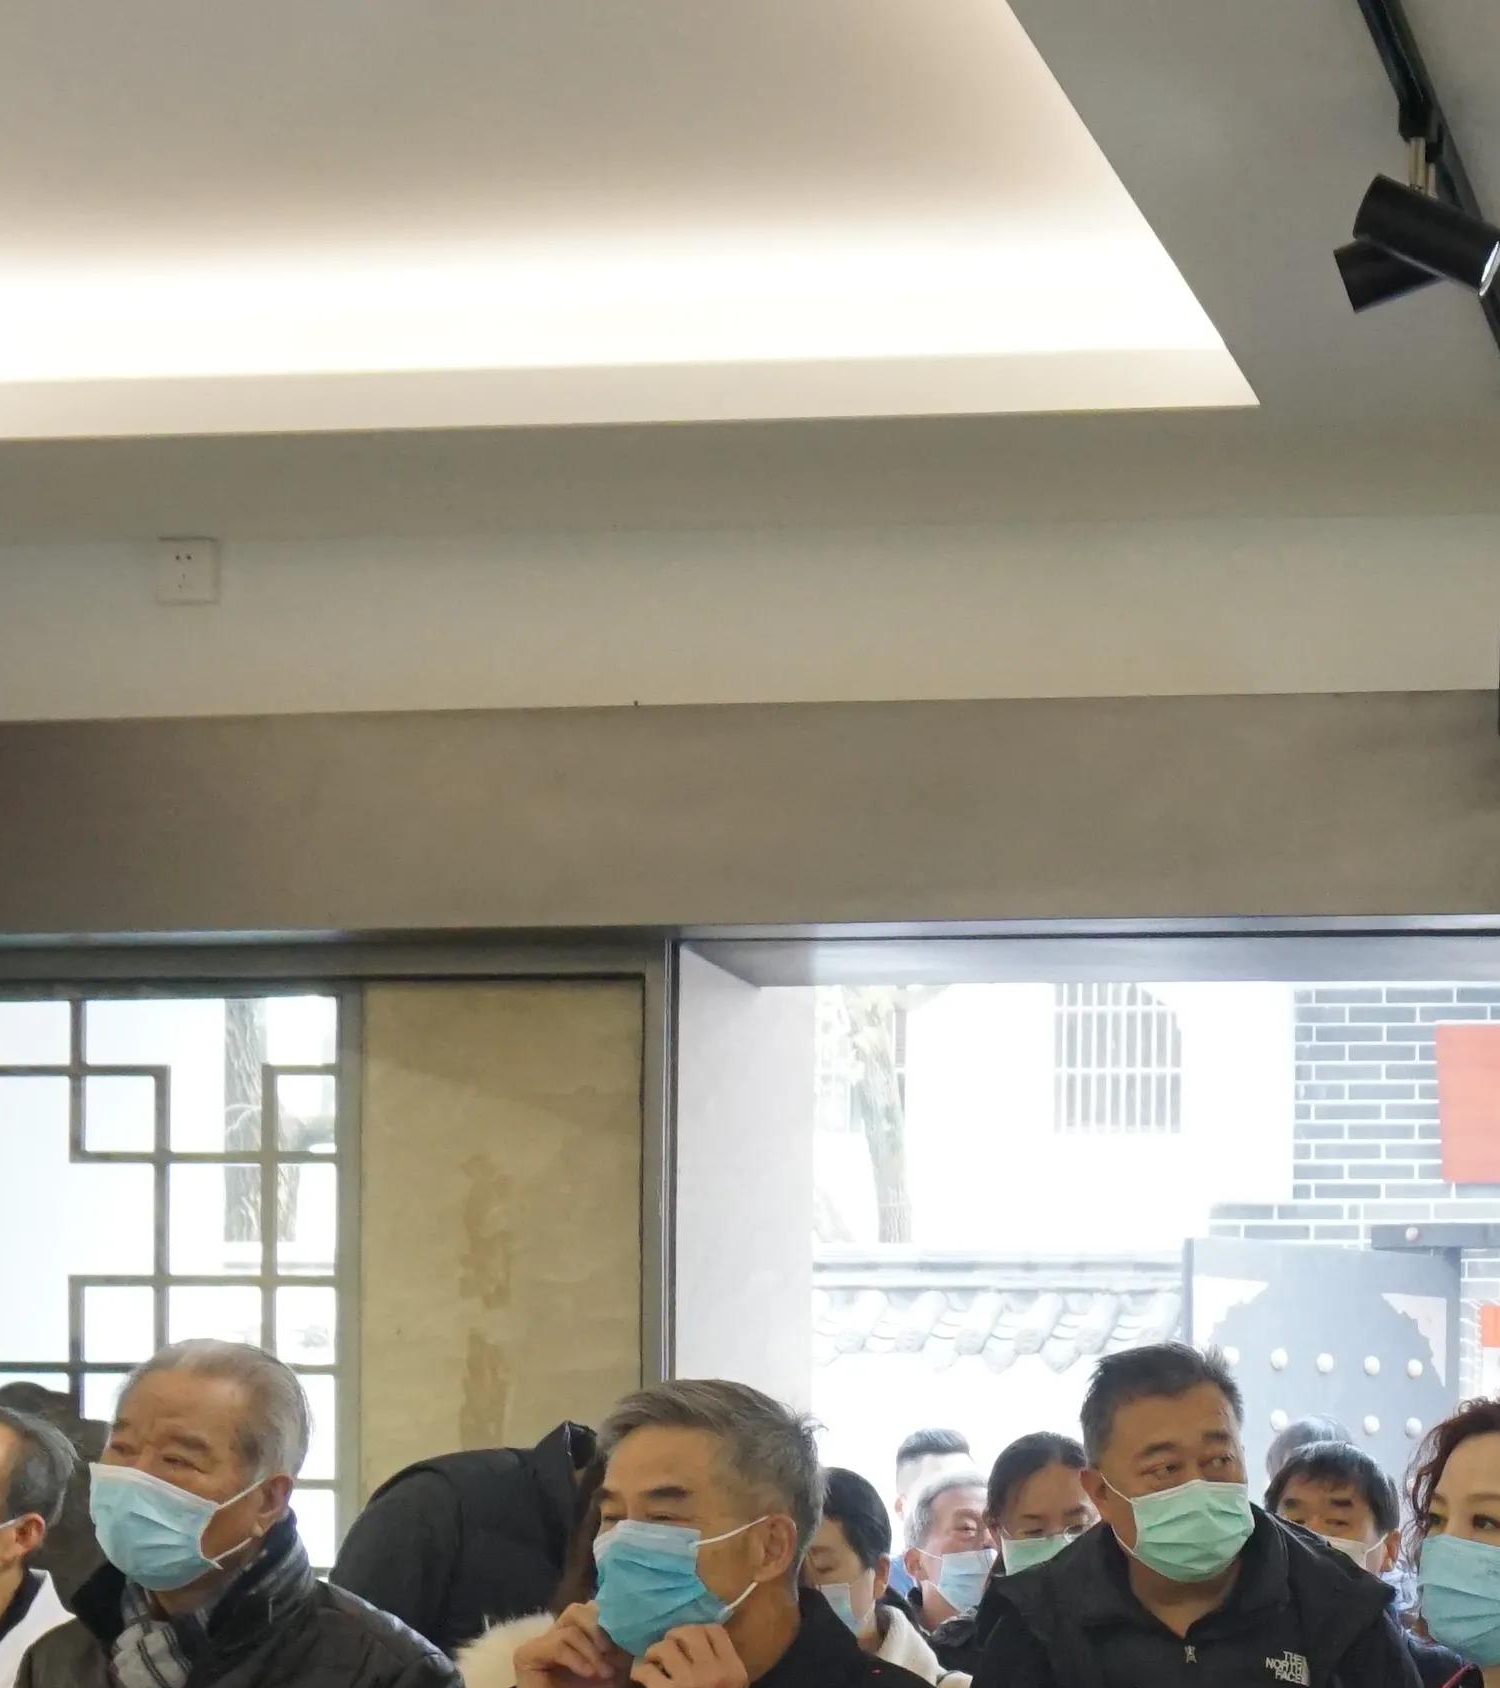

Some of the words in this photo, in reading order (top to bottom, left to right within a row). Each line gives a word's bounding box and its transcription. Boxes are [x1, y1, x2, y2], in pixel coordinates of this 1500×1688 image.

[1283, 1650, 1302, 1666] THE
[1265, 1657, 1303, 1677] NORTH
[1275, 1668, 1303, 1685] FACE
